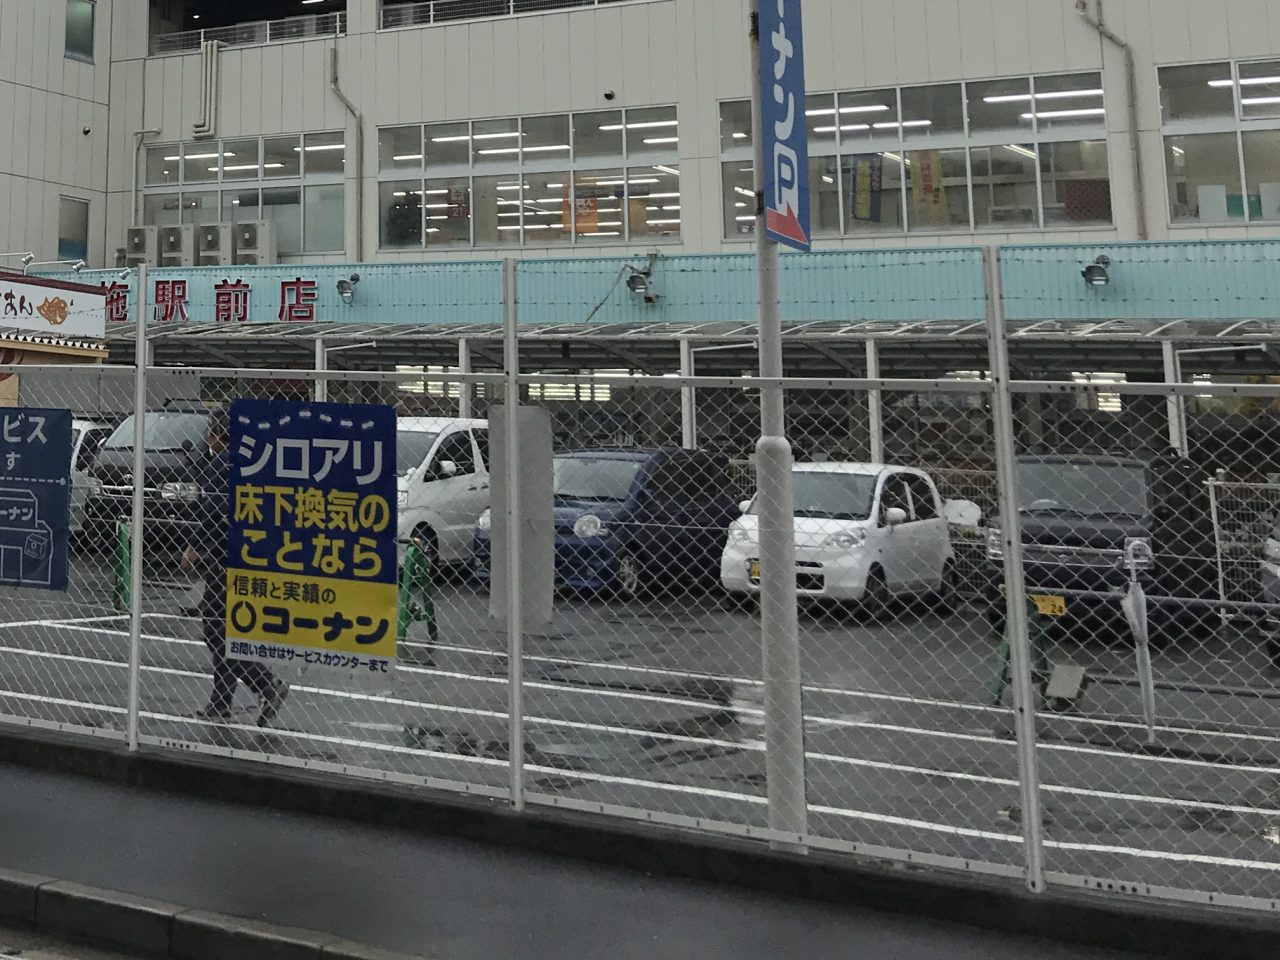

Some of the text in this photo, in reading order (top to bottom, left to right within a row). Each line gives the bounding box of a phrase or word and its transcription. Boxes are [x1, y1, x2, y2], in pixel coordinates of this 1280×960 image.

[238, 434, 383, 486] シロアリ
[234, 483, 390, 533] 床下換気の
[240, 529, 382, 578] ことなら
[232, 574, 337, 605] 信頼と実績の
[262, 605, 389, 645] コーナン
[230, 641, 389, 673] お問い合せはサービスカウンターまで
